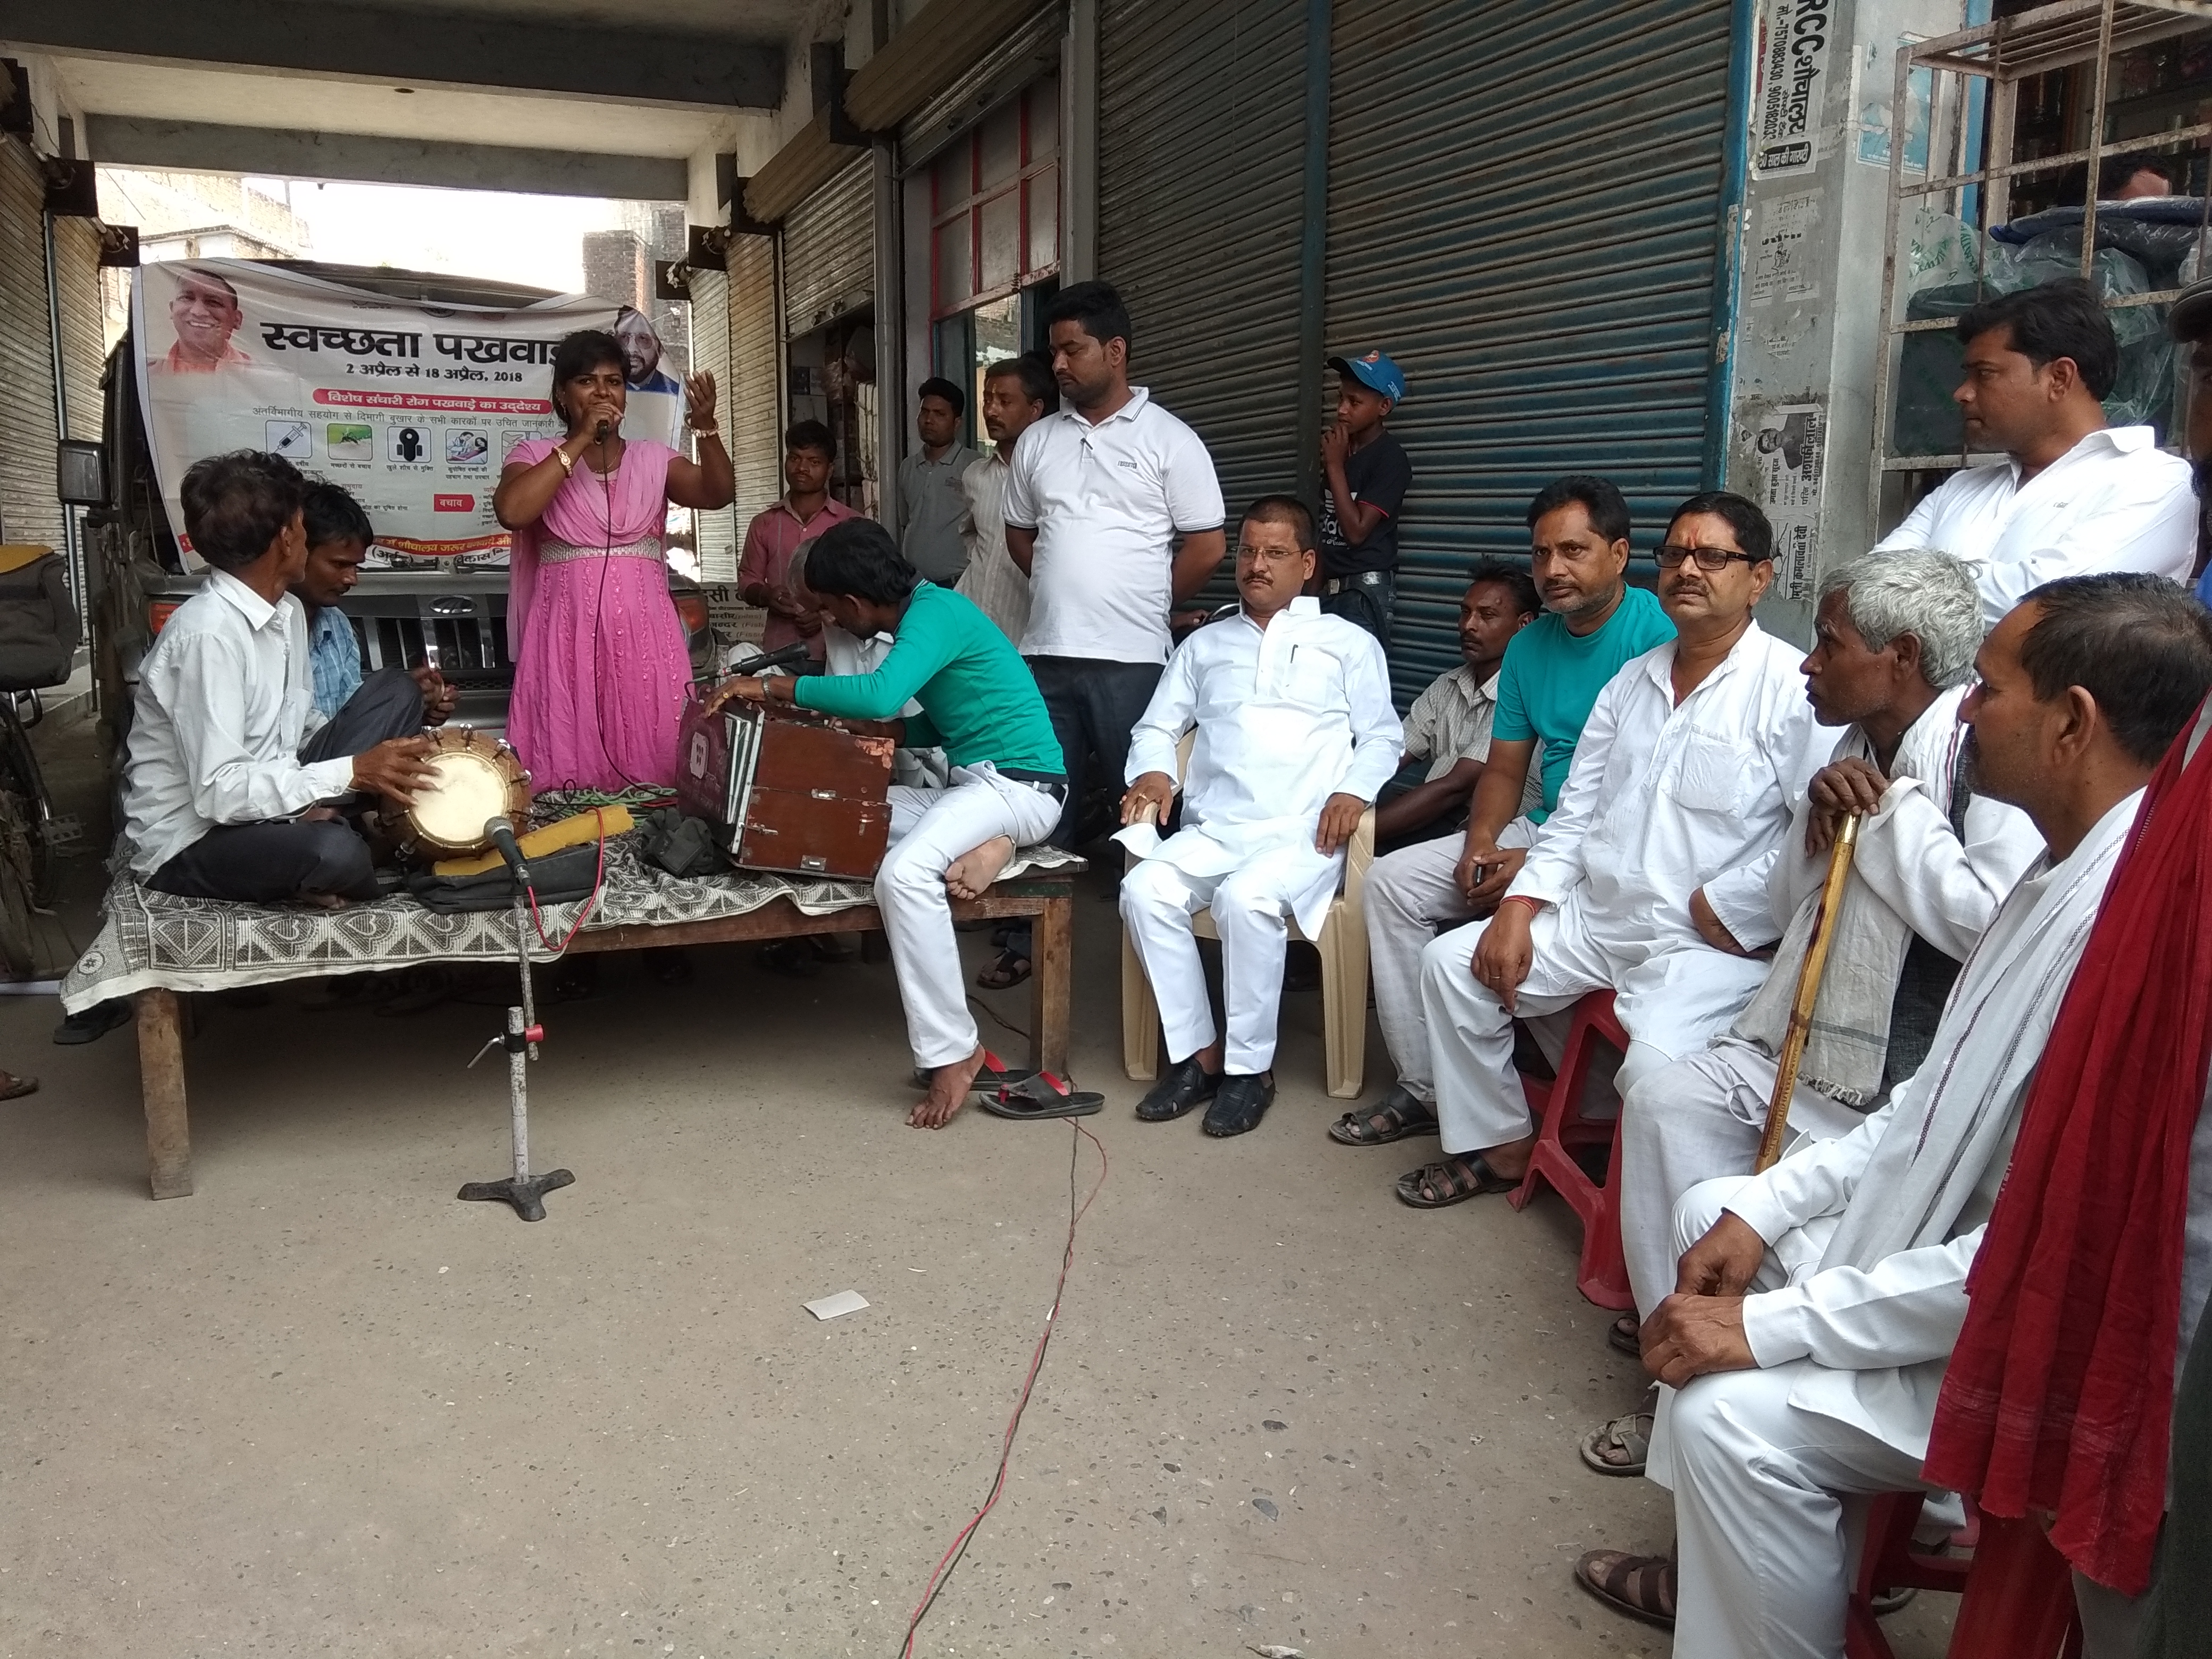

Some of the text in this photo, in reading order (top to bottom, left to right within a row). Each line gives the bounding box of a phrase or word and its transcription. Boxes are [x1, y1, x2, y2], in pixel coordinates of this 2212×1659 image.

[1768, 153, 1781, 167] साल
[1781, 146, 1789, 165] की
[259, 322, 559, 366] स्वच्छता पखवा
[346, 362, 523, 382] 2 अप्रैल से 18 अप्रैल, 2018
[328, 391, 541, 413] विशेष संचारी रोग पखवाड़े का उद्देश्य
[253, 406, 303, 418] अंतर्विभागीय
[308, 408, 339, 420] सहयोग
[344, 409, 352, 420] से
[357, 411, 384, 422] दिमागी
[390, 413, 412, 425] बुखार
[417, 413, 425, 423] के
[430, 415, 446, 425] सभी
[451, 416, 476, 426] कारकों
[496, 417, 517, 427] उचित
[522, 418, 555, 428] जानकारी
[439, 499, 463, 507] बचाव
[398, 540, 437, 553] शौचालय
